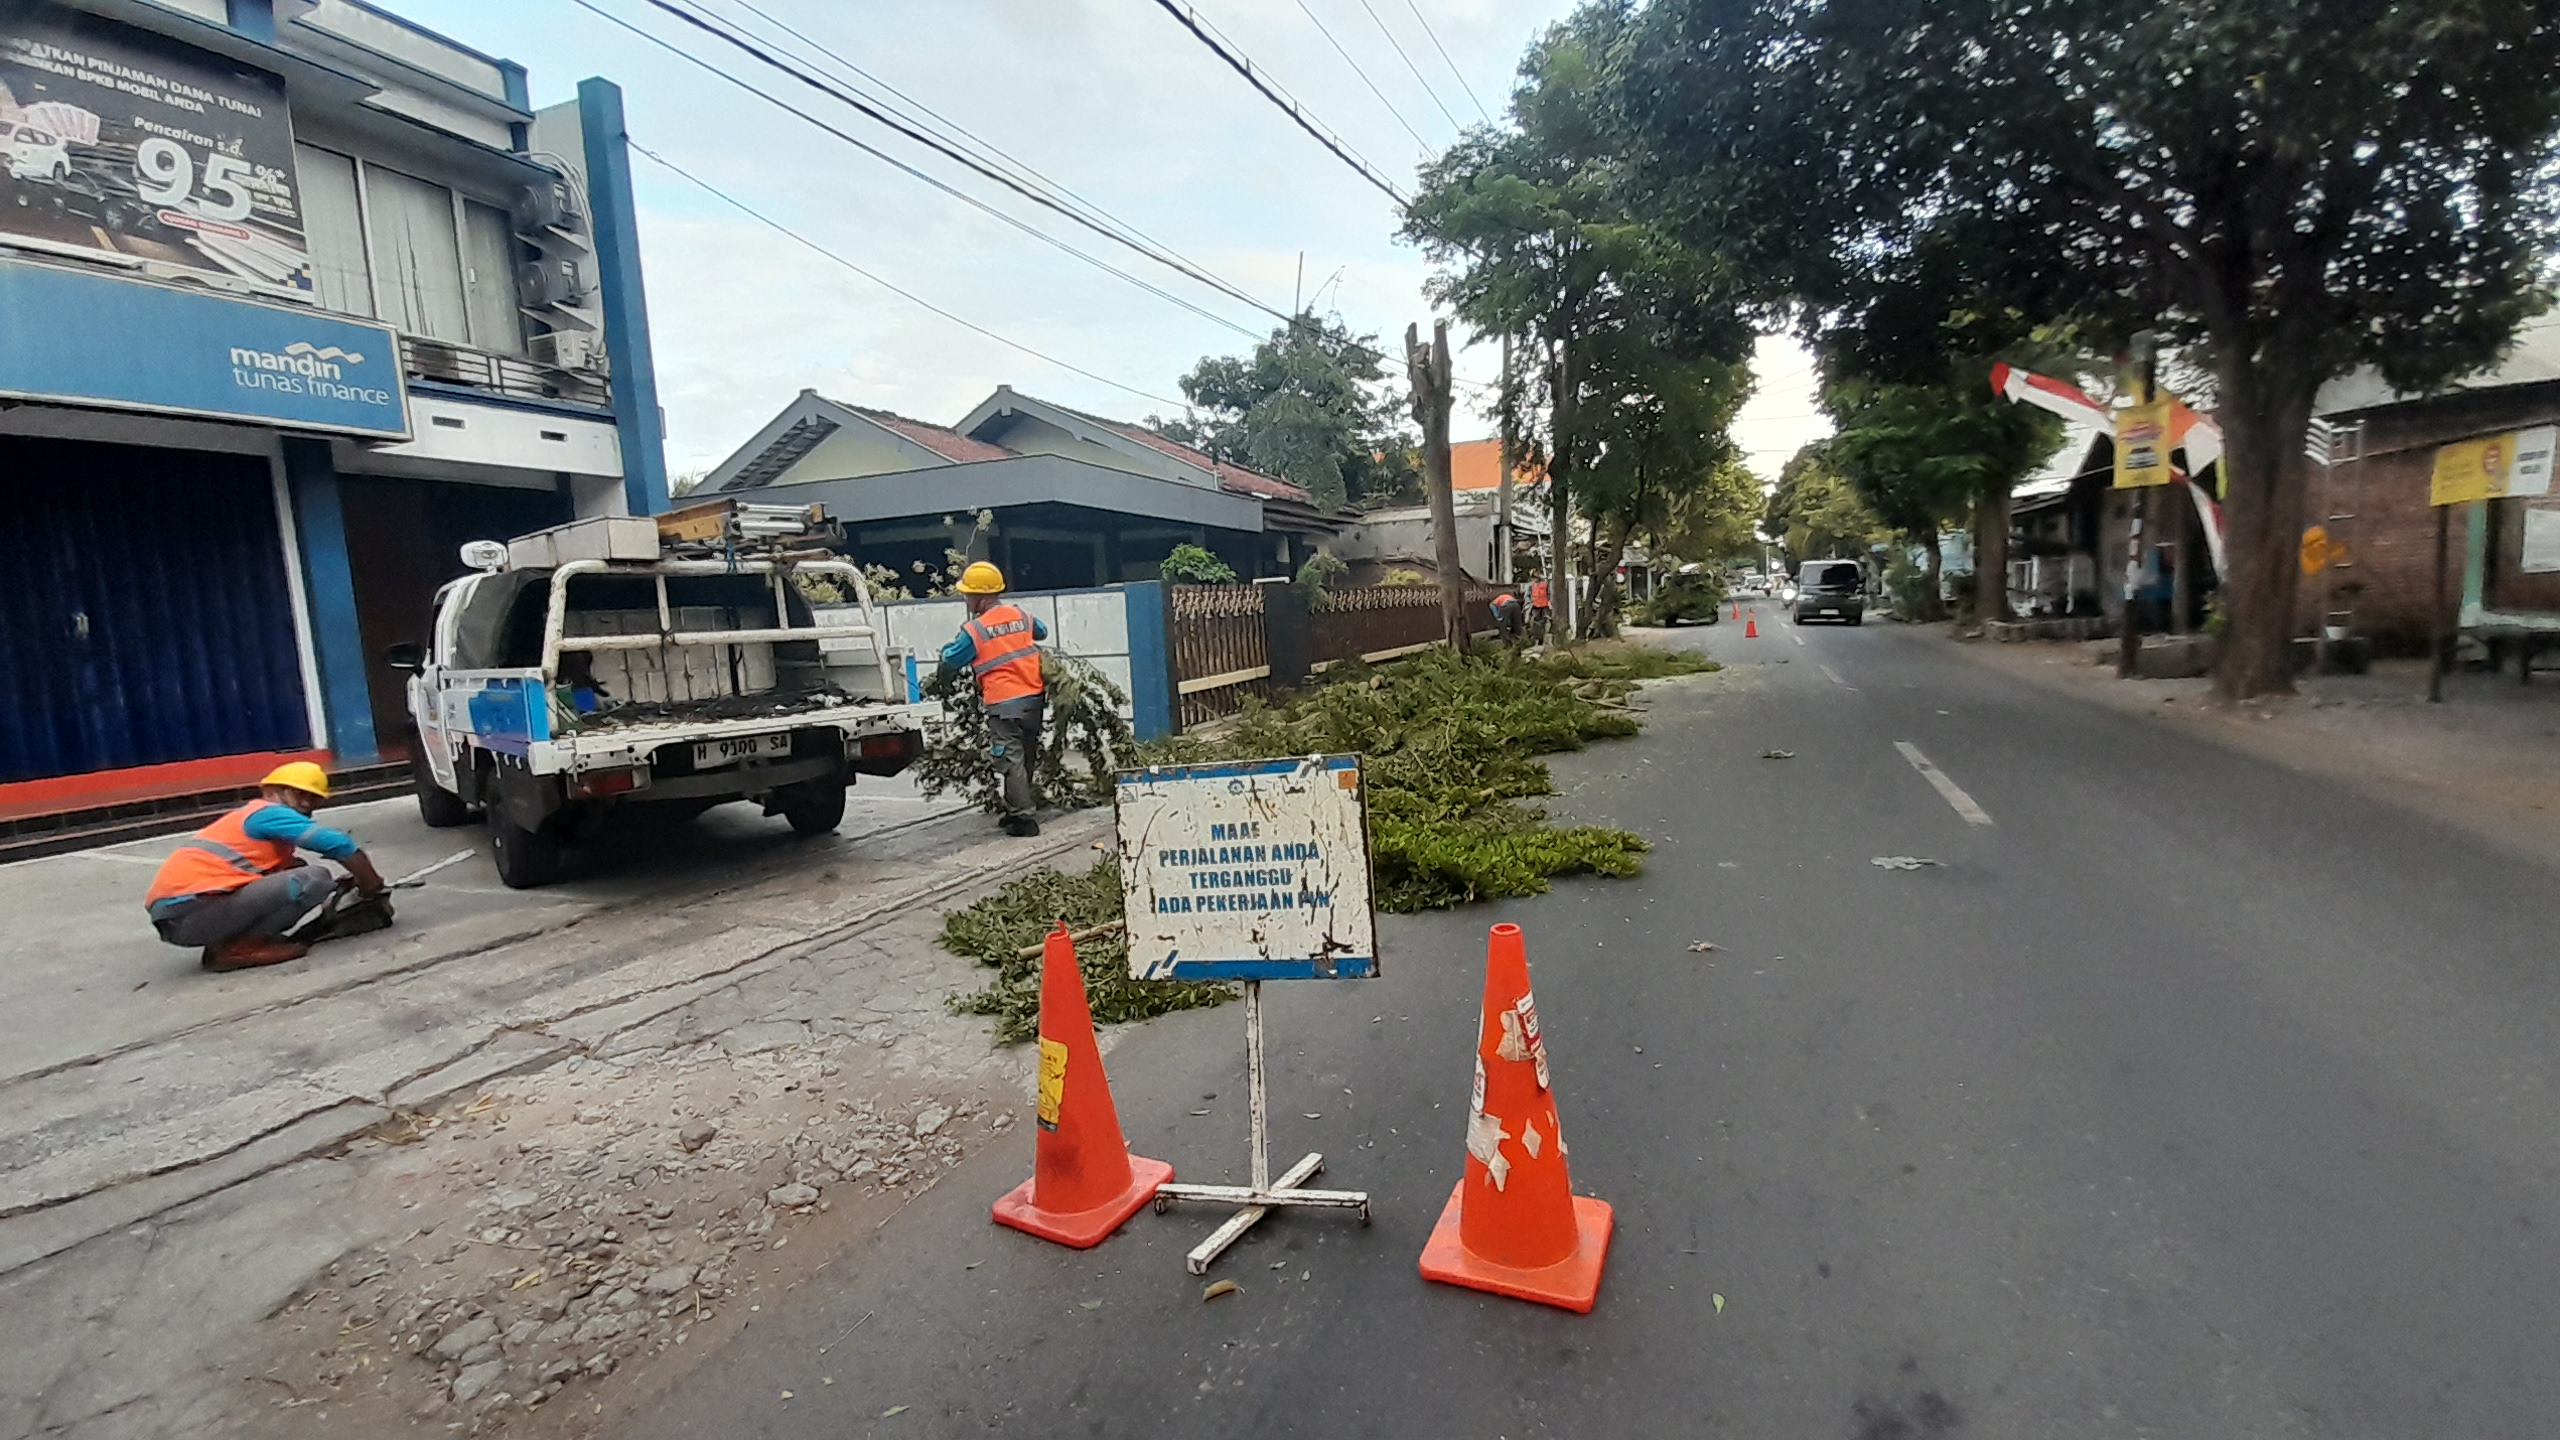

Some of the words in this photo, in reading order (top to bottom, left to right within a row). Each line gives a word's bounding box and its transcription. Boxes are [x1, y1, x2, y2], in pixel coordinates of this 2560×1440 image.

[77, 66, 115, 88] BPKB
[116, 79, 162, 102] MOBIL
[164, 93, 205, 114] ANDA
[88, 56, 168, 91] PINJAMAN
[170, 81, 215, 105] DANA
[216, 93, 263, 118] TUNAI
[134, 116, 214, 148] Pencairan
[232, 367, 303, 394] tunas
[306, 375, 390, 406] finance
[697, 743, 707, 760] H
[769, 735, 788, 751] SA
[1210, 821, 1261, 842] MAAF
[1158, 844, 1267, 868] PERJALANAN
[1271, 841, 1320, 862] ANDA
[1188, 868, 1293, 890] TERGANGGU
[1157, 896, 1193, 914] ADA
[1195, 890, 1294, 913] PEKERJAAN
